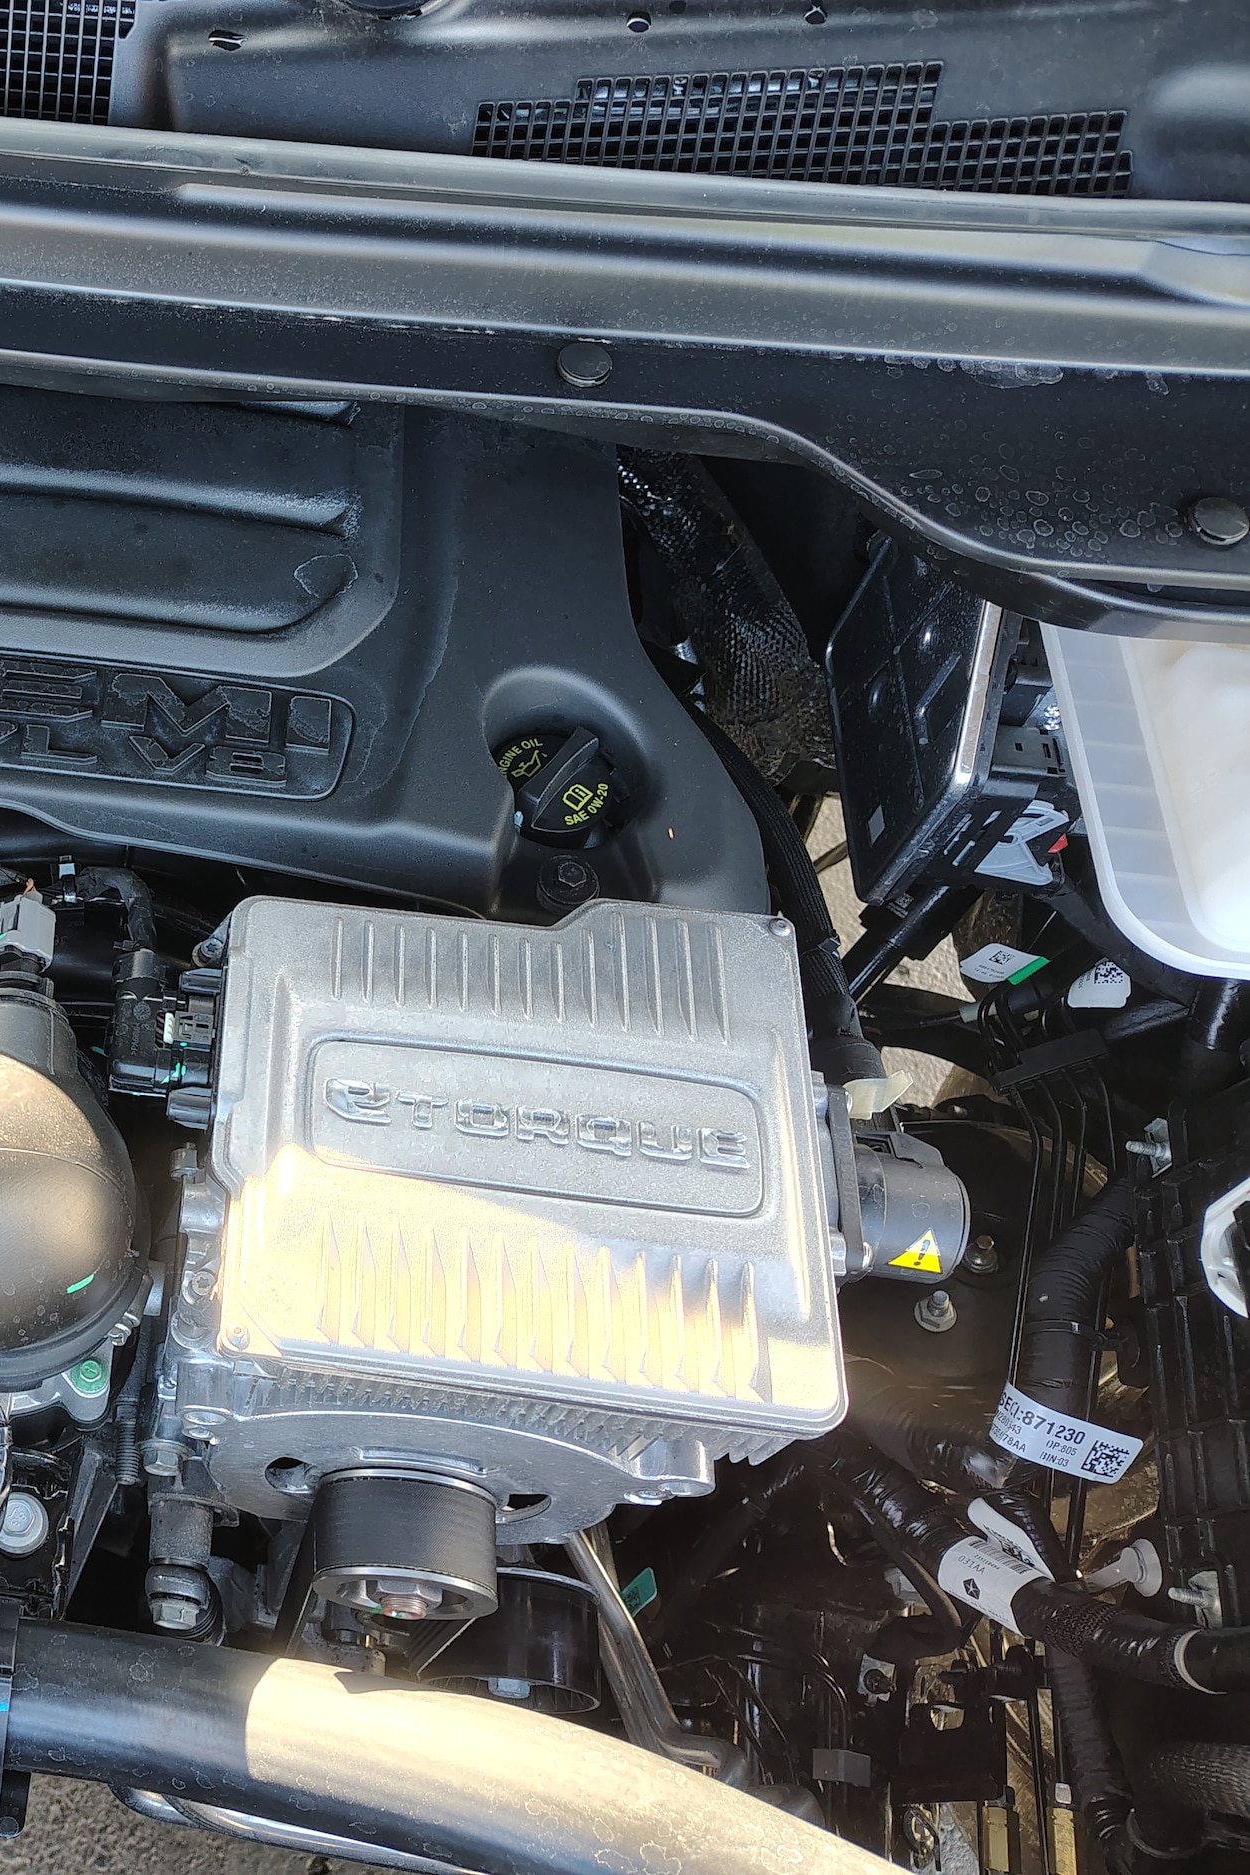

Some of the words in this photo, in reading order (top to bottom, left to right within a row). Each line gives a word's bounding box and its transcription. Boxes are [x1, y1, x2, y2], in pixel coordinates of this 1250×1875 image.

[128, 735, 287, 786] V8
[498, 745, 523, 777] NGINE
[520, 738, 543, 749] OIL
[564, 810, 590, 826] SAE
[587, 783, 609, 814] 0W-20
[323, 1078, 750, 1171] eTORQUE
